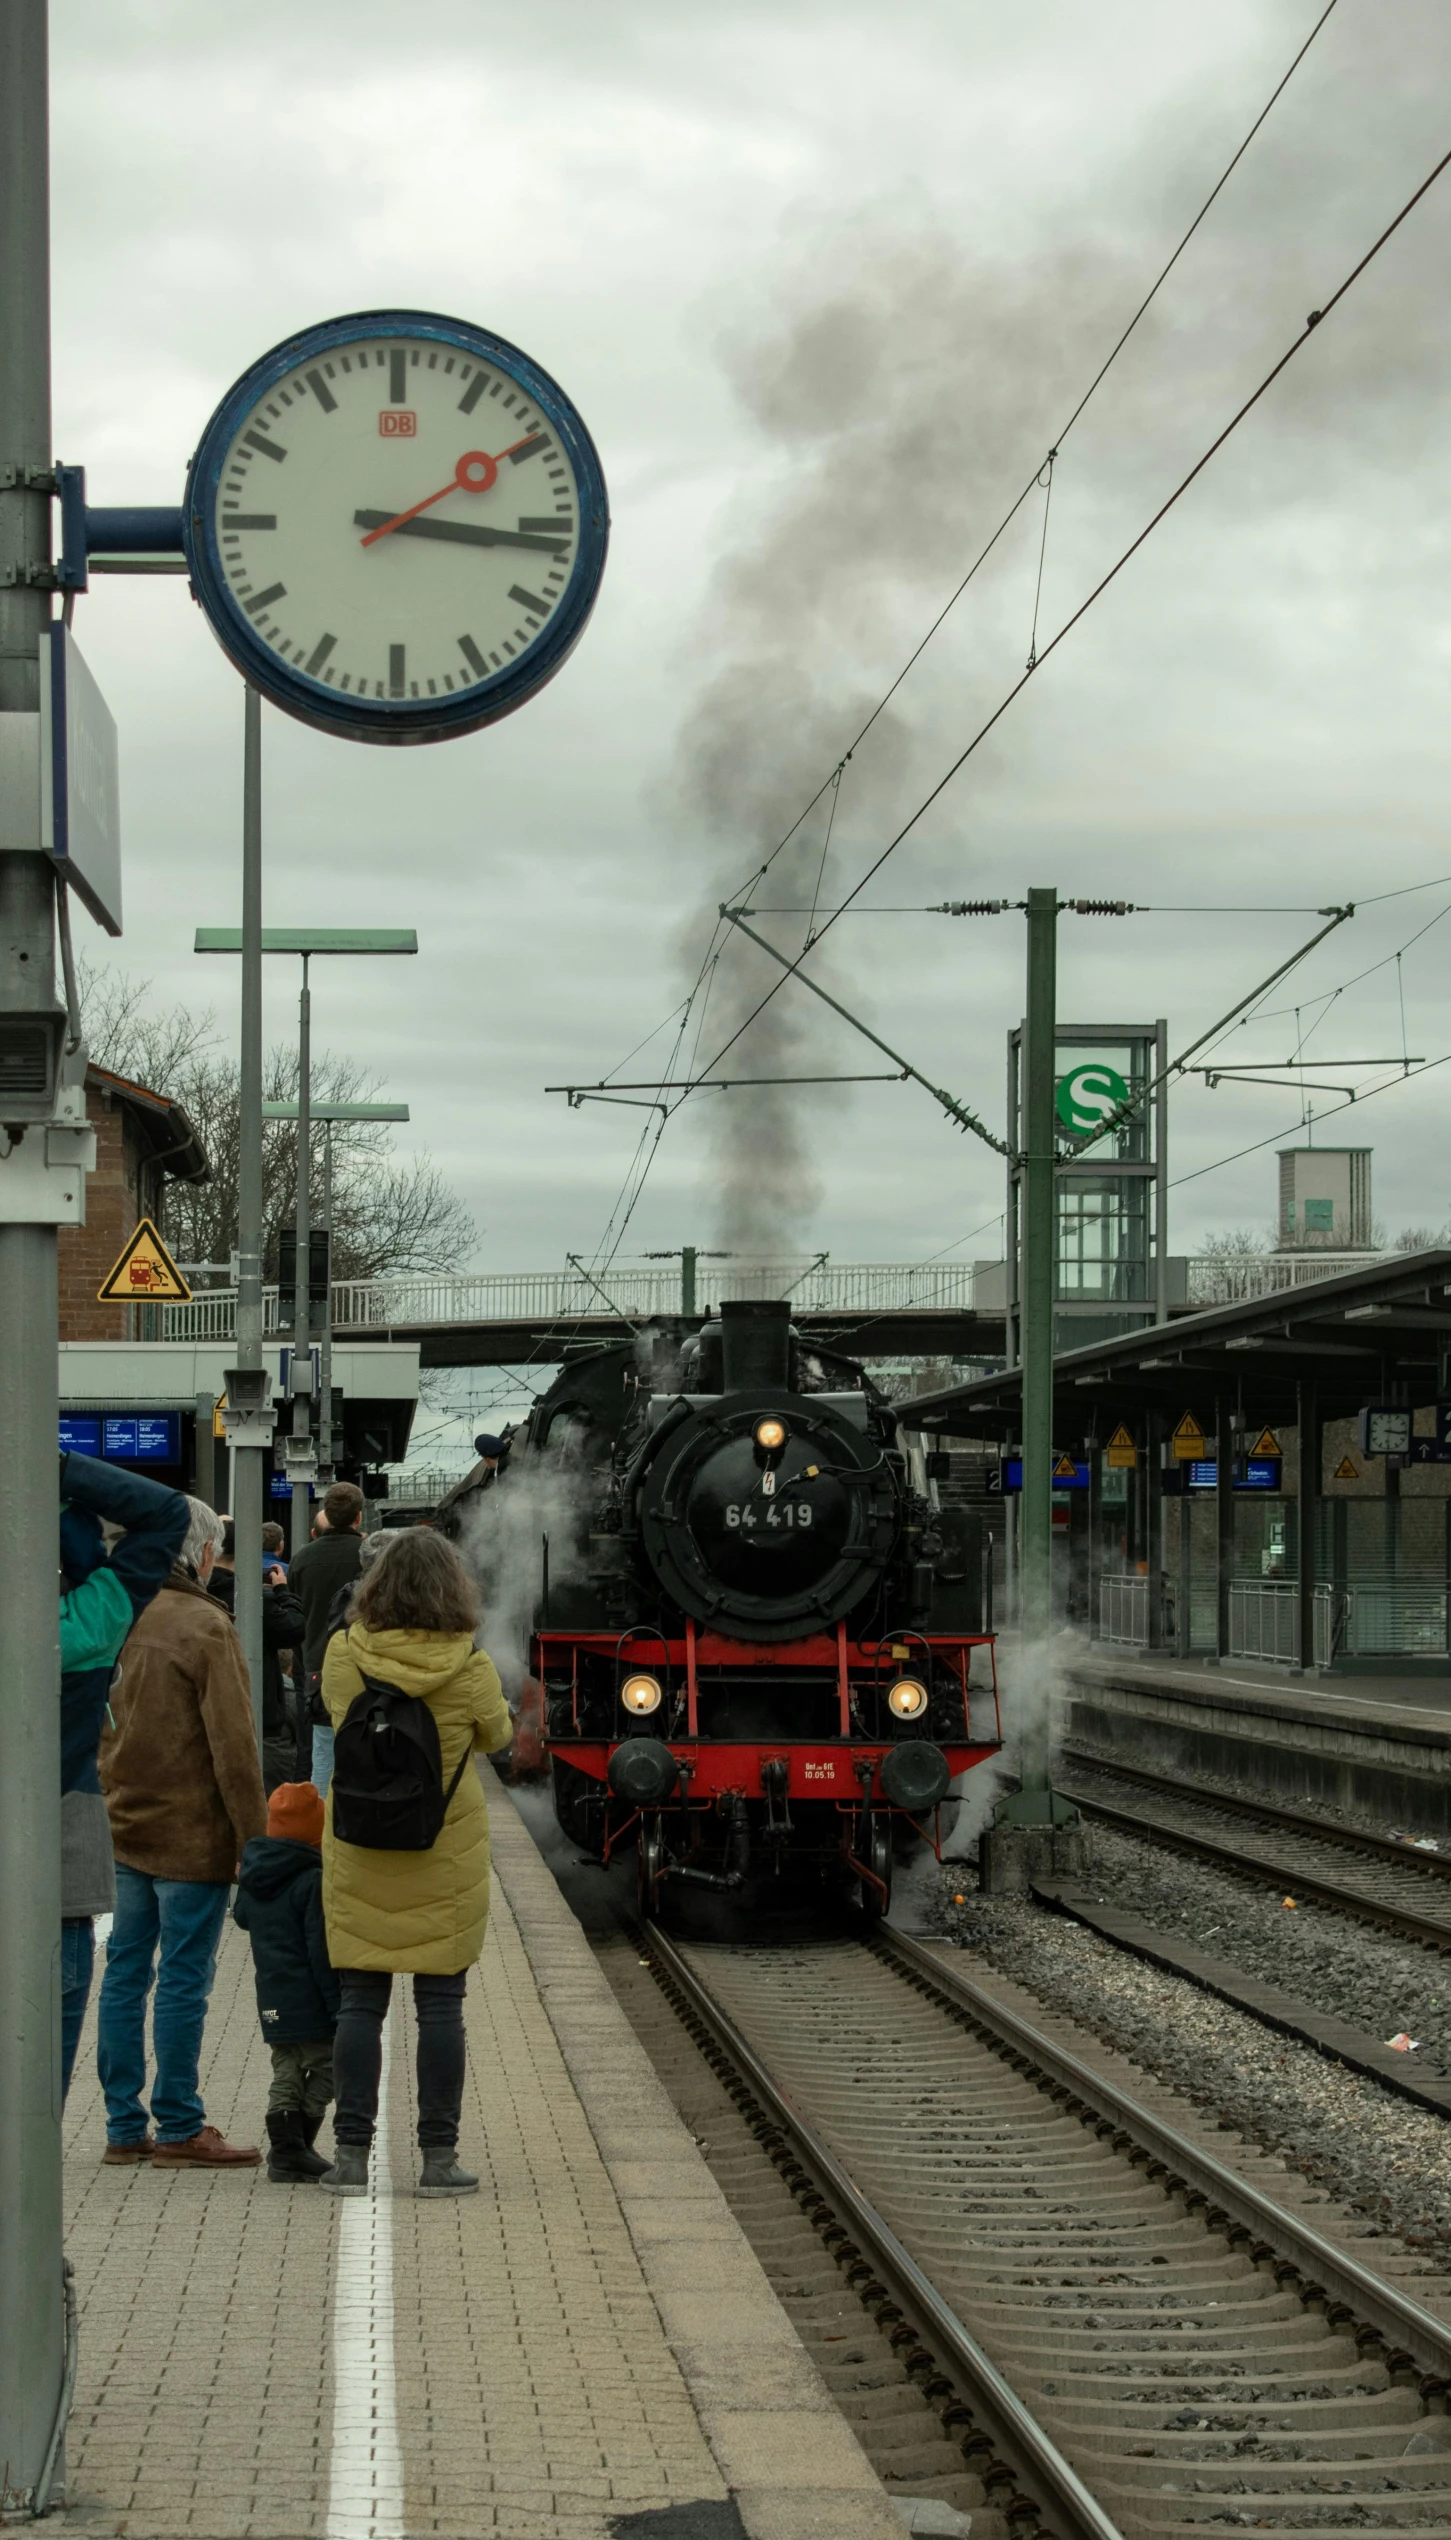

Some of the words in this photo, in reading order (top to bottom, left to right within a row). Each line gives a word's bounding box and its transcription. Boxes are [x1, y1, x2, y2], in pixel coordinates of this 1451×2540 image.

[383, 414, 413, 434] DB
[1069, 1070, 1117, 1130] S
[725, 1504, 757, 1528] 64
[766, 1504, 813, 1528] 419
[804, 1771, 835, 1780] 10.05.19
